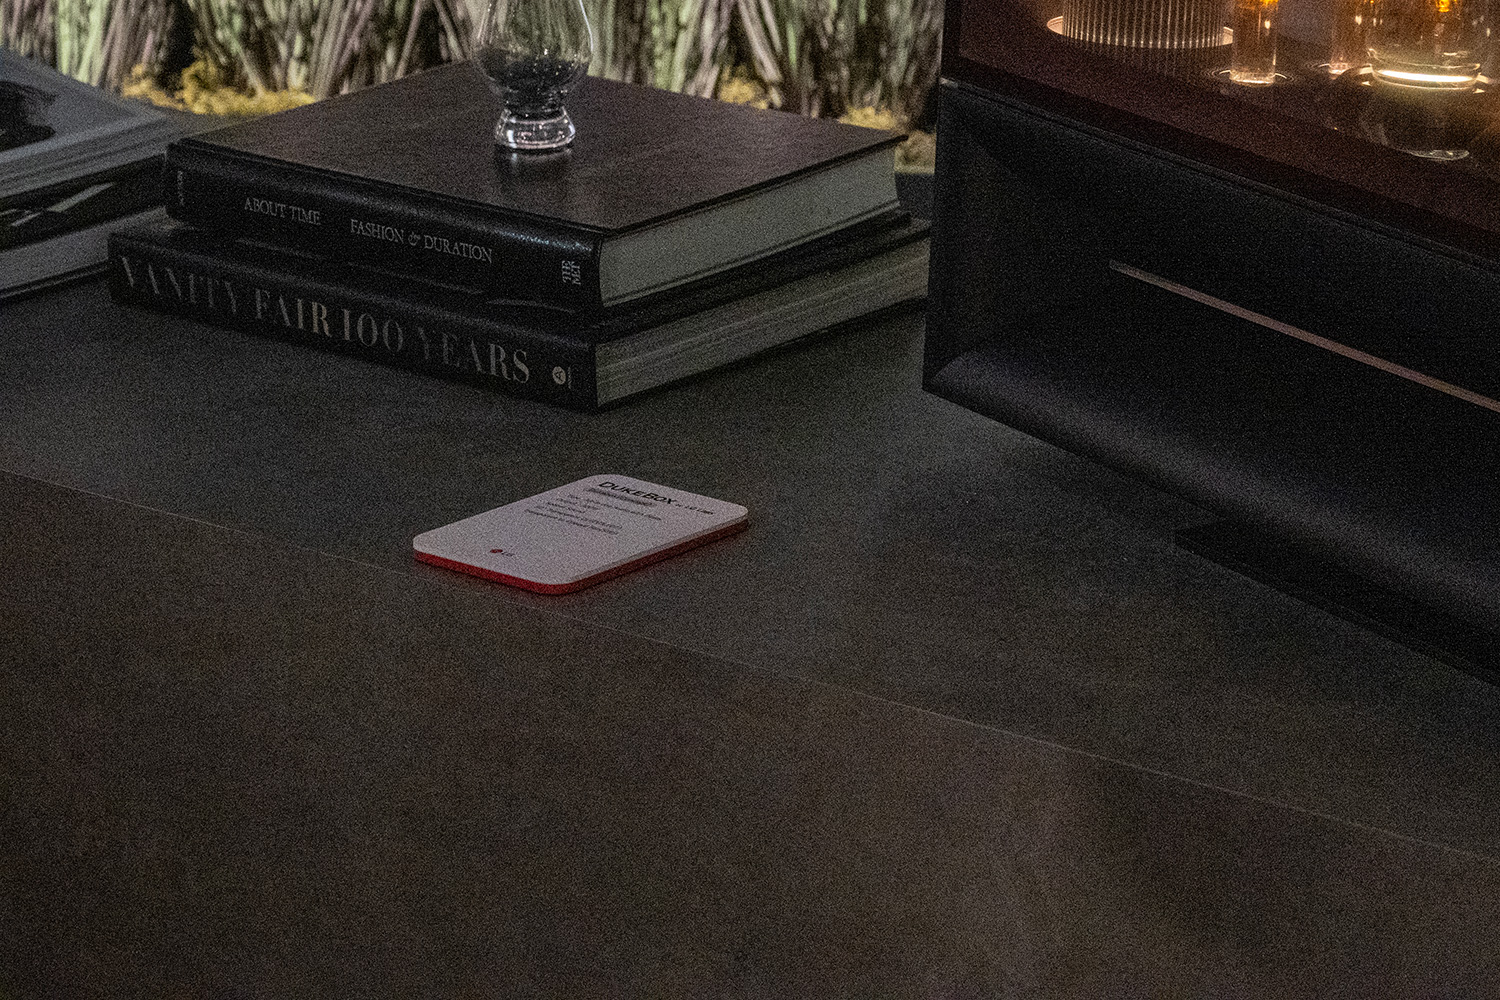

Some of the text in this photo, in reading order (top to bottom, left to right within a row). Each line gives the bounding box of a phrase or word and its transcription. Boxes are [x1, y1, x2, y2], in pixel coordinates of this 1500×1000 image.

[243, 197, 322, 226] ABOUT TIME
[350, 219, 404, 245] FASHION
[424, 235, 493, 264] DURATION
[120, 255, 239, 314] VANITY
[255, 288, 332, 338] FAIR
[417, 326, 531, 383] YEARS
